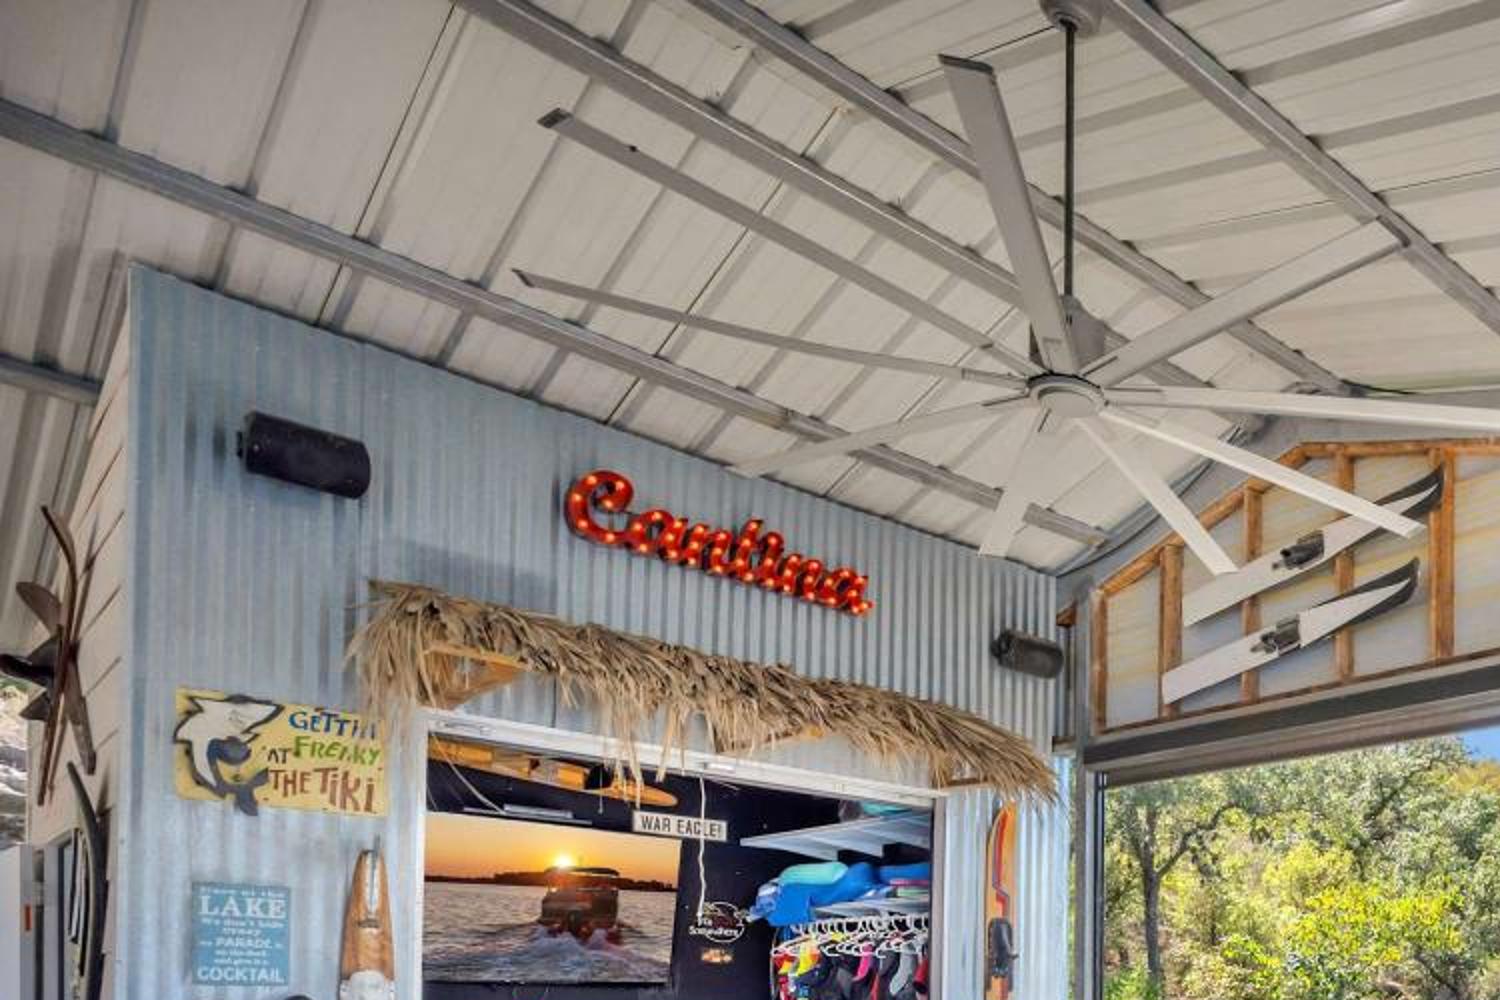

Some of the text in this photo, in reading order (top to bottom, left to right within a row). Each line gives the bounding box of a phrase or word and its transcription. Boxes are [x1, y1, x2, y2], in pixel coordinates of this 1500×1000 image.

[563, 469, 874, 617] Cantina
[269, 769, 311, 798] THE
[641, 814, 671, 832] WAR
[198, 896, 287, 919] LAKE
[197, 967, 286, 983] COCKTAIL
